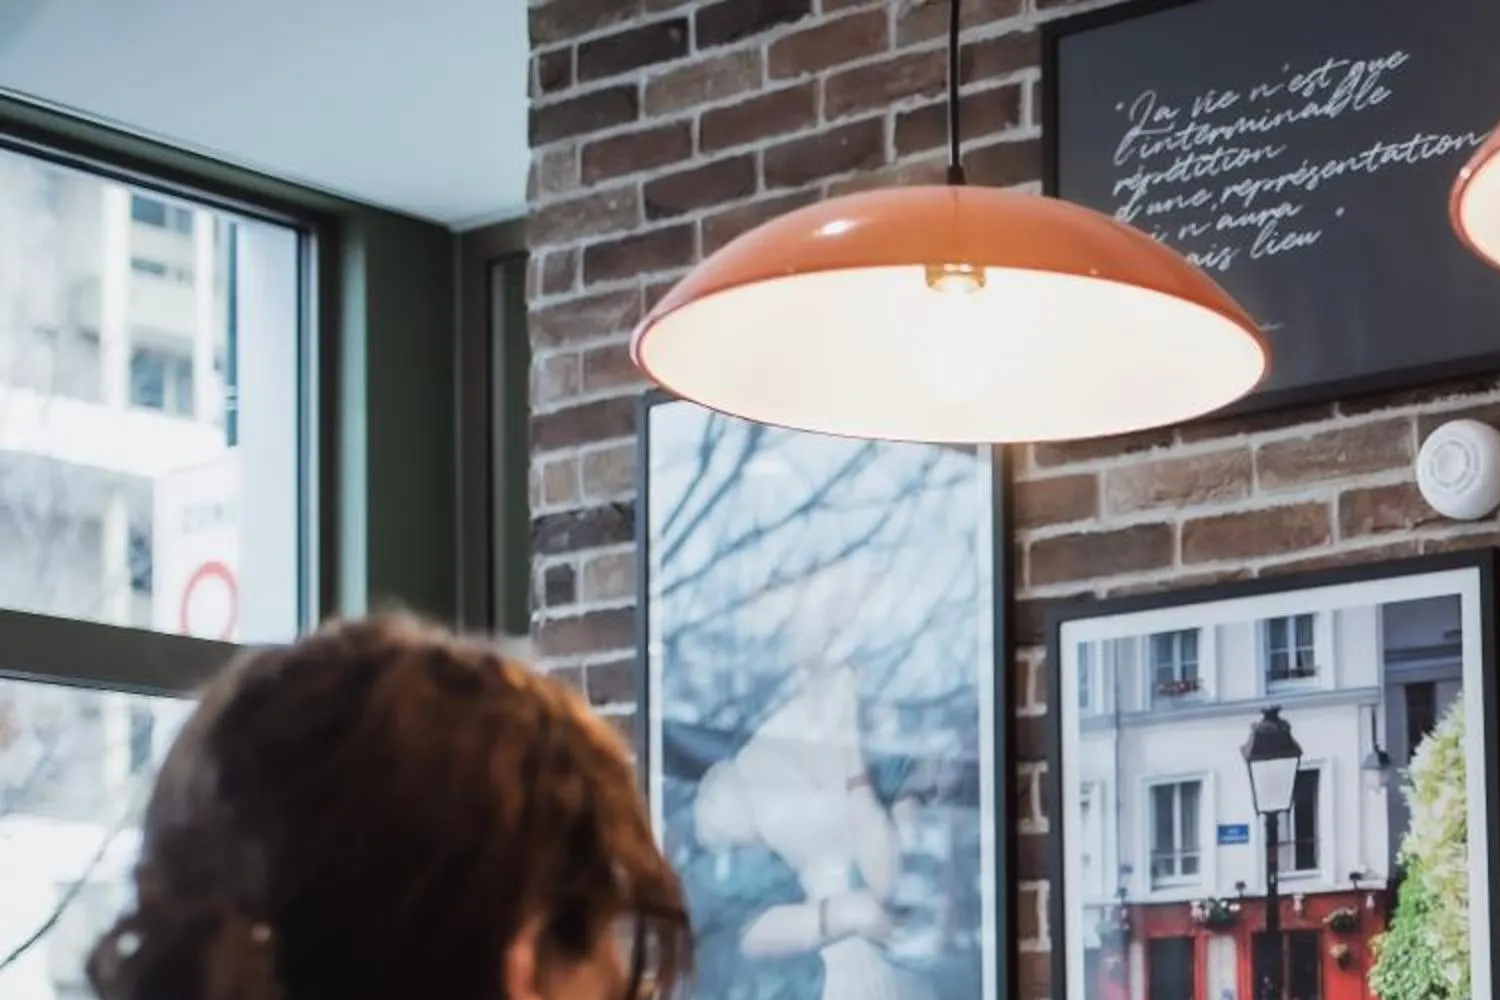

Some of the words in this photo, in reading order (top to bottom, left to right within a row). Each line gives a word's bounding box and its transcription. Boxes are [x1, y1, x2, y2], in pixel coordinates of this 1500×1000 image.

[1190, 89, 1241, 119] vie
[1249, 57, 1350, 101] n'est
[1346, 50, 1410, 98] que
[1219, 131, 1490, 208] représentation
